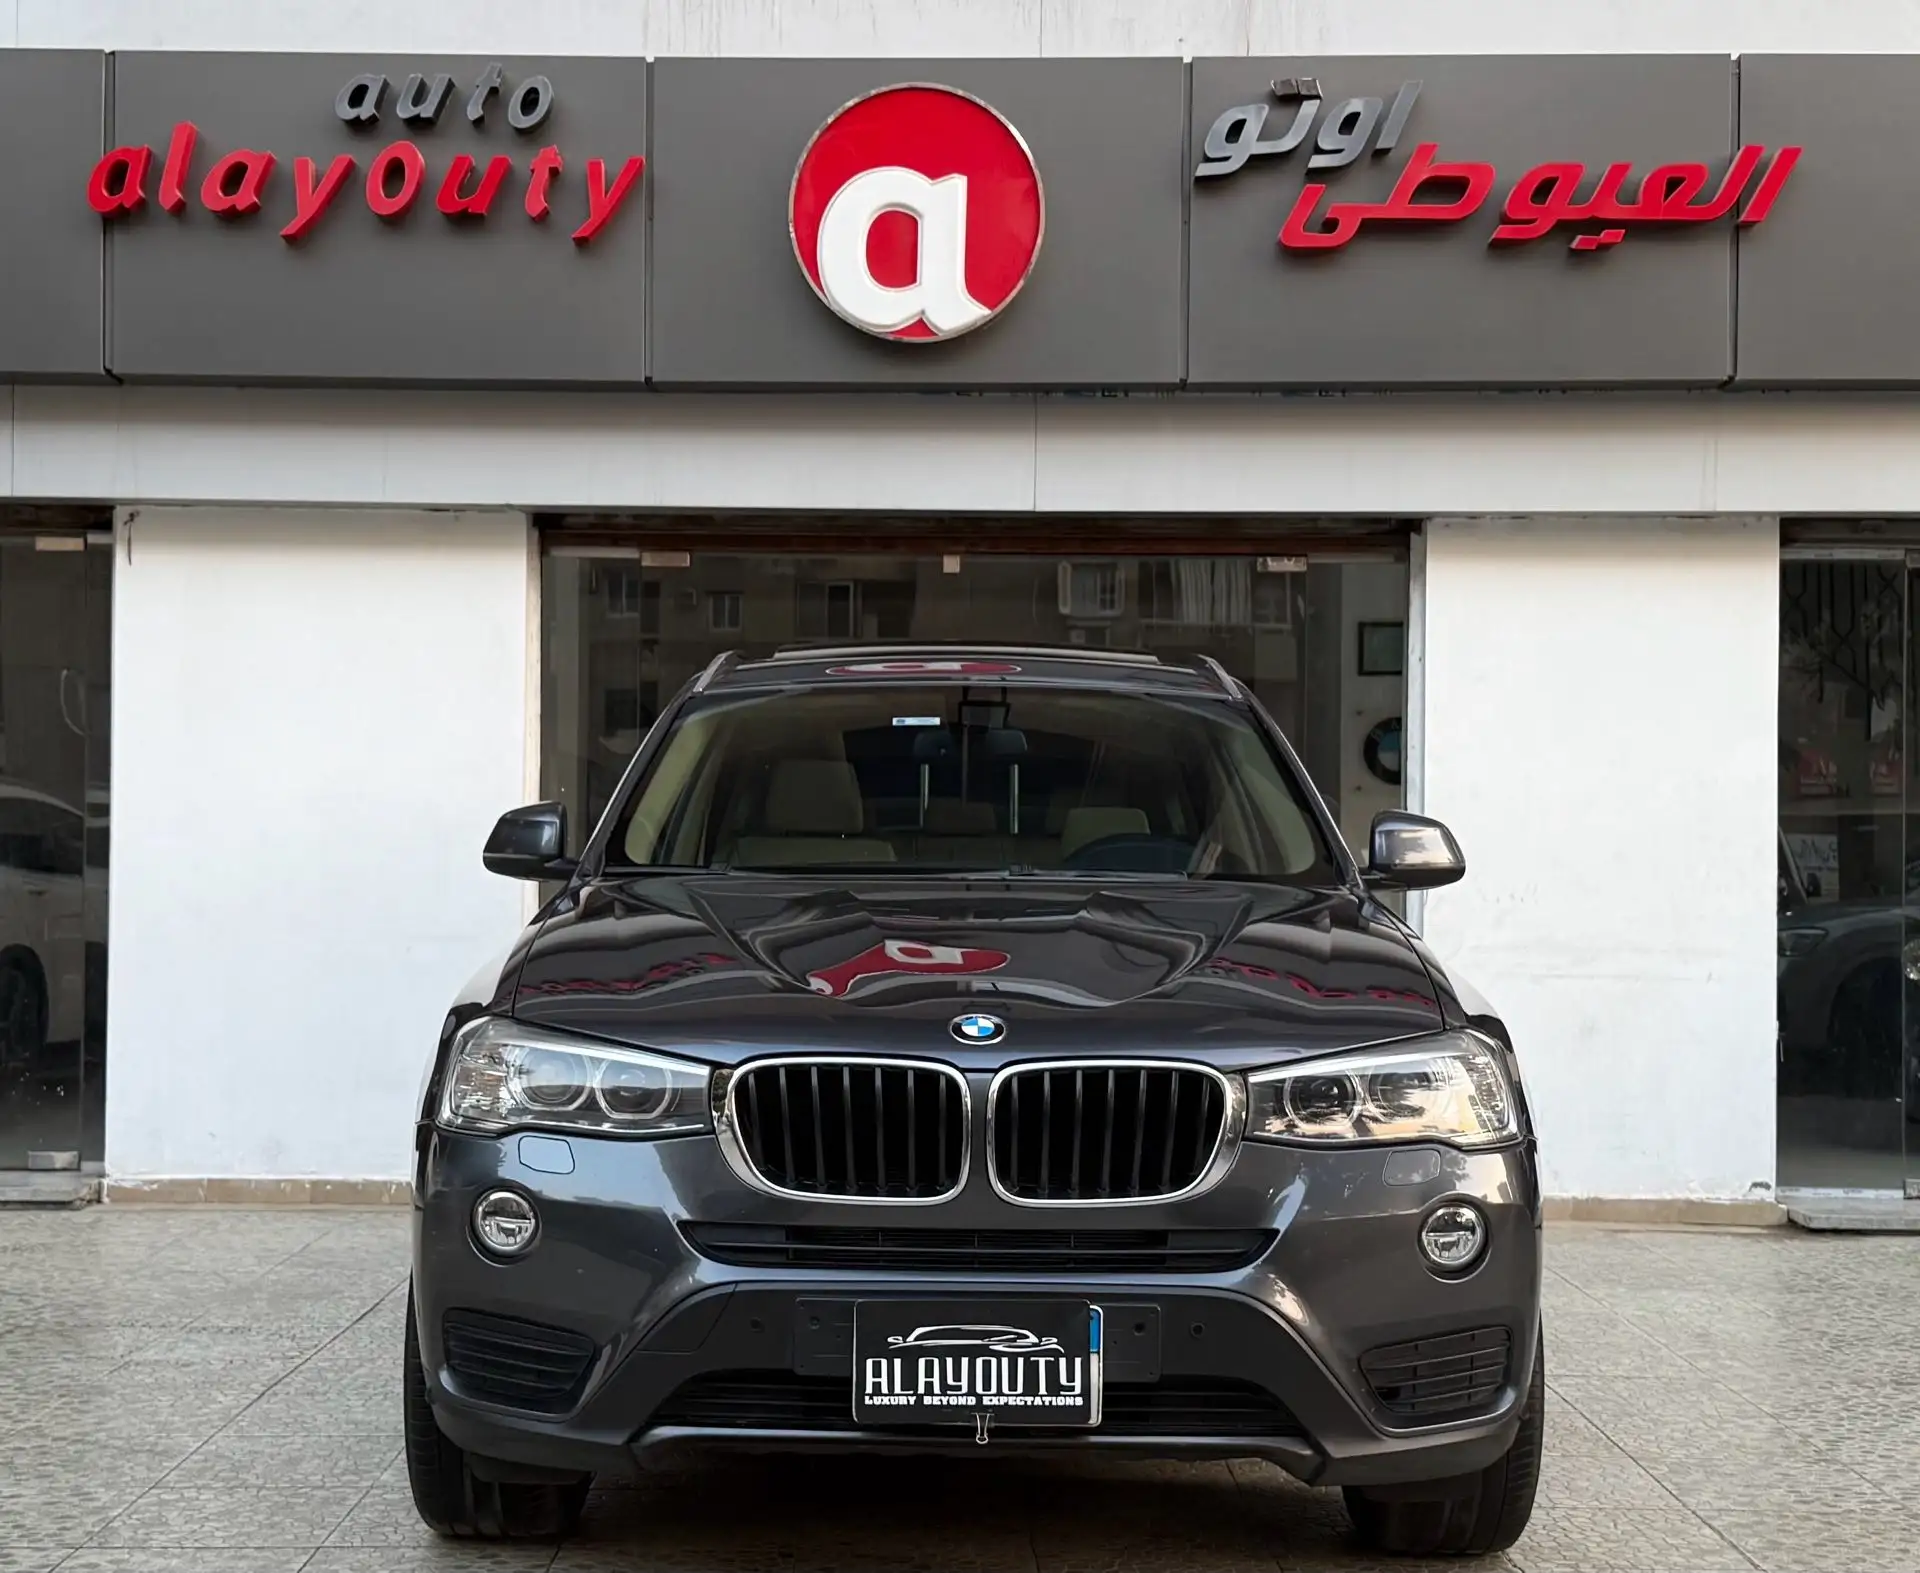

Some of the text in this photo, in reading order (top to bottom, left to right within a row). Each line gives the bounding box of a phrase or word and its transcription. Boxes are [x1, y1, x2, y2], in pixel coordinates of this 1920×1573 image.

[335, 63, 555, 132] auto
[1194, 77, 1423, 177] اوتو
[86, 121, 645, 243] alayouty
[816, 165, 992, 336] a
[864, 1356, 1083, 1395] ALAYOUTY
[864, 1396, 1084, 1406] LUXURY BEYOND EXPECTATIONS
